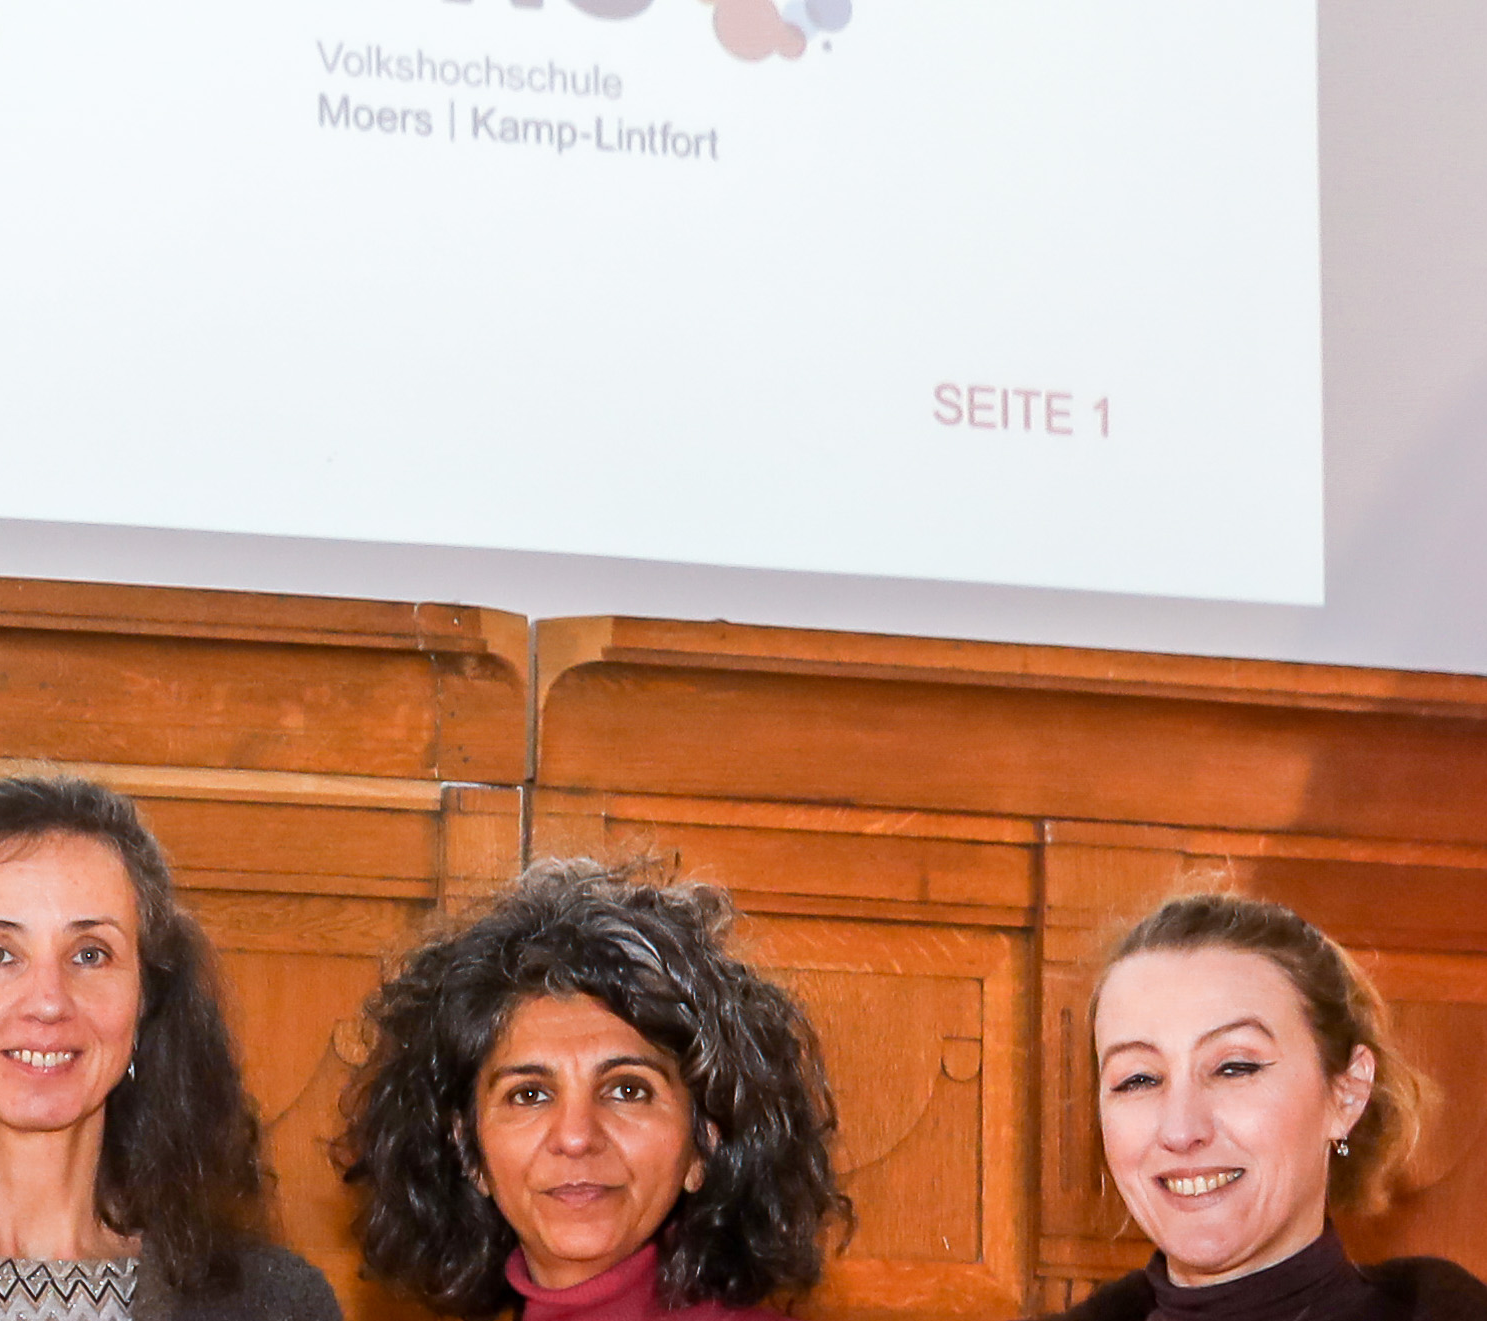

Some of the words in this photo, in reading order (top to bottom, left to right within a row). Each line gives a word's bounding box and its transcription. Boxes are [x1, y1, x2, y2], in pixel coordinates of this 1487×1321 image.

[316, 40, 623, 101] Volkshochschule
[317, 93, 433, 138] Moers
[470, 105, 720, 161] Kamp-Lintfort
[933, 382, 1074, 437] SEITE
[1093, 396, 1110, 439] 1
